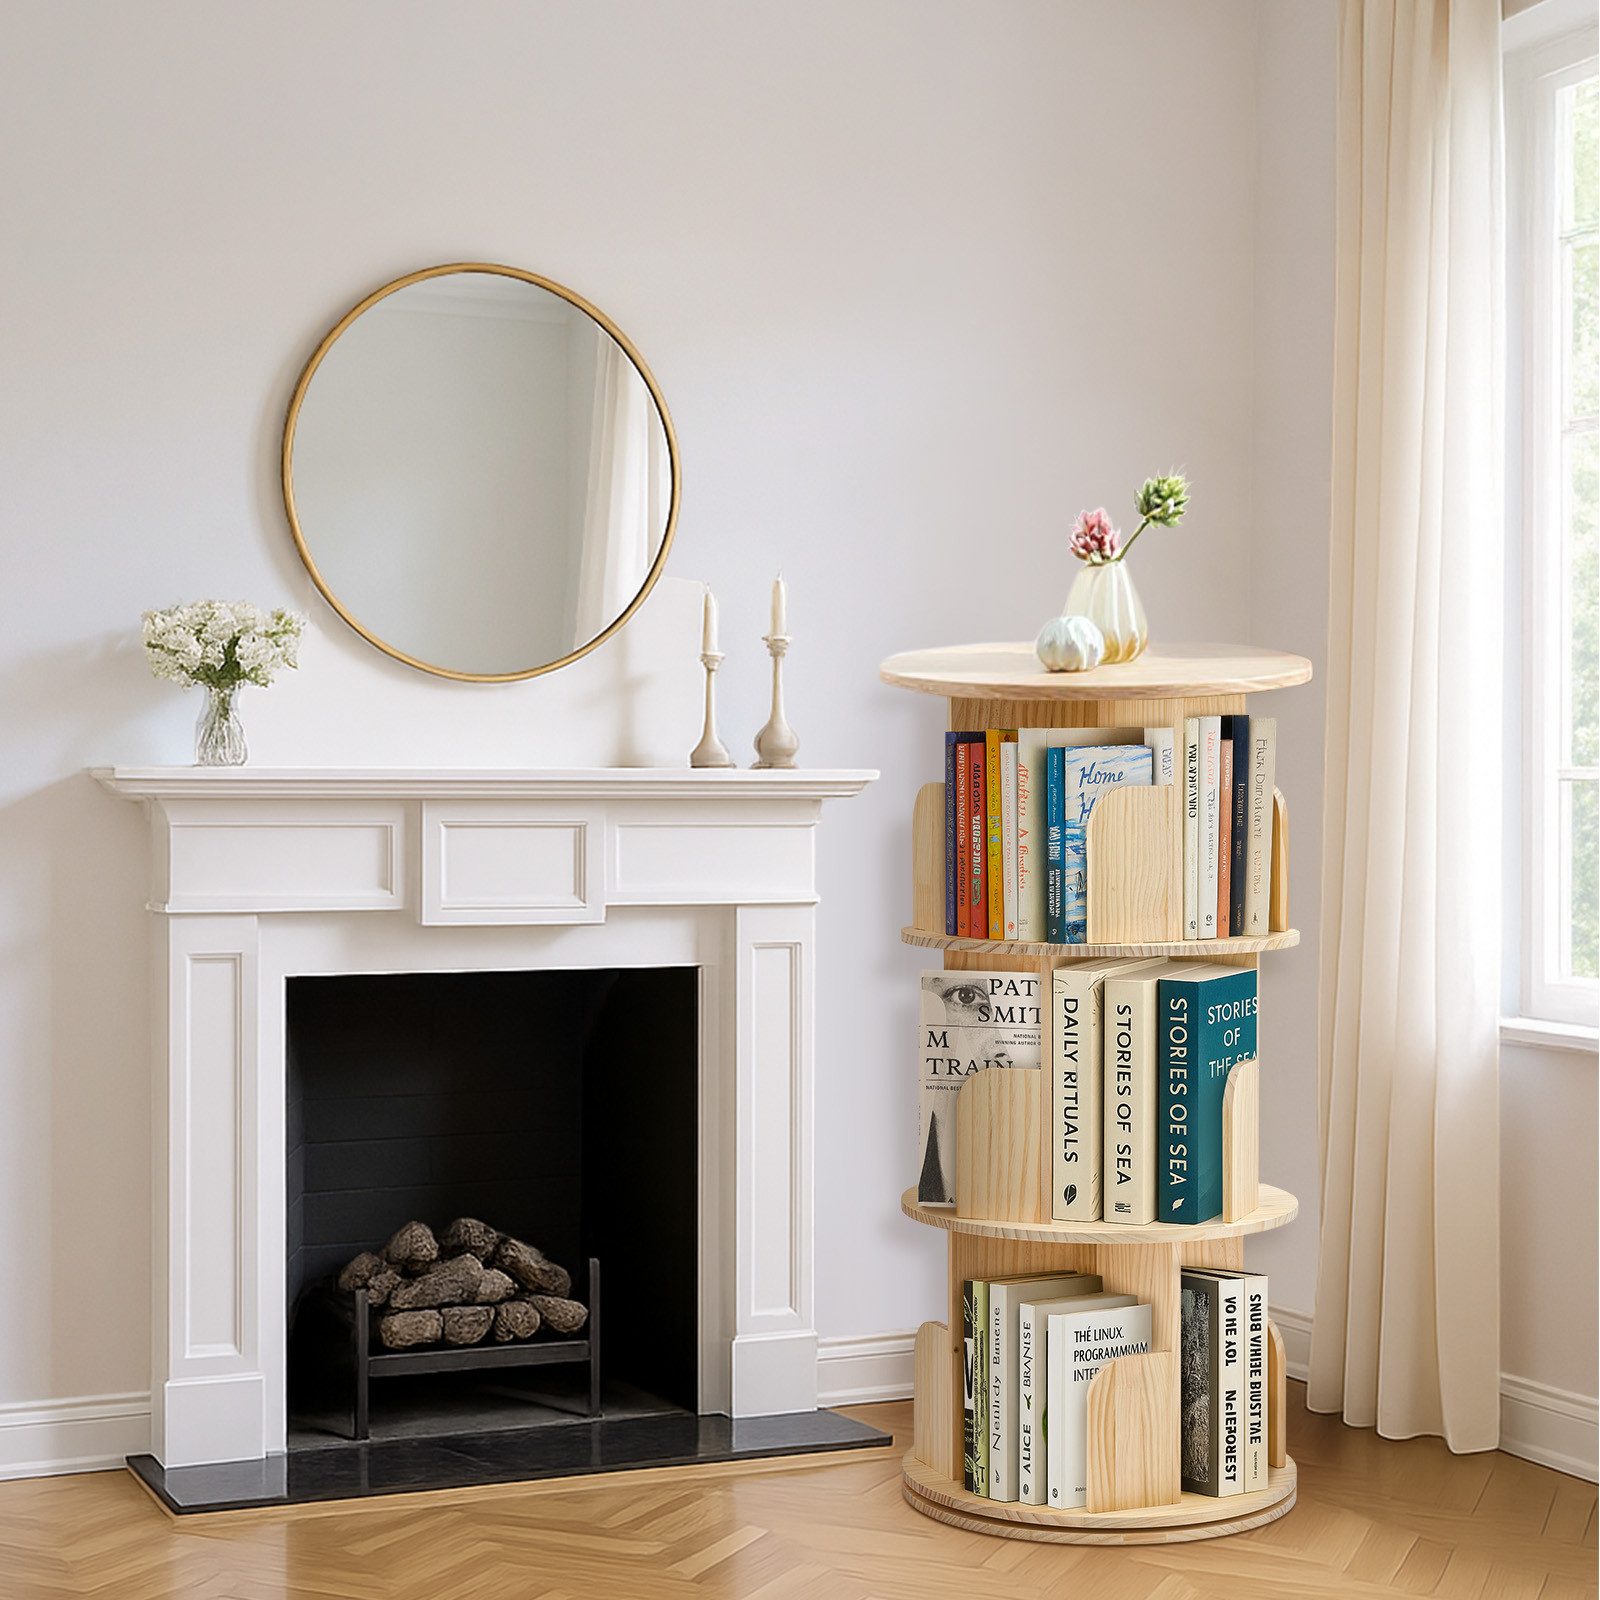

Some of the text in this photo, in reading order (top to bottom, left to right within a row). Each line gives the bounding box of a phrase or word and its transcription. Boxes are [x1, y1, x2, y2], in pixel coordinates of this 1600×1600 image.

[1079, 761, 1125, 788] Home
[989, 979, 1041, 997] PAT
[1207, 996, 1257, 1025] STORIES
[926, 1030, 949, 1049] M
[1115, 1004, 1132, 1096] STORIES
[1170, 997, 1188, 1096] STORIES
[1223, 1027, 1241, 1046] OF
[1063, 998, 1079, 1163] DAILY RITUALS
[1208, 1057, 1232, 1078] THE
[1115, 1103, 1132, 1133] OF
[1115, 1144, 1132, 1185] SEA
[1170, 1144, 1188, 1187] SEA
[1022, 1423, 1032, 1474] ALICE
